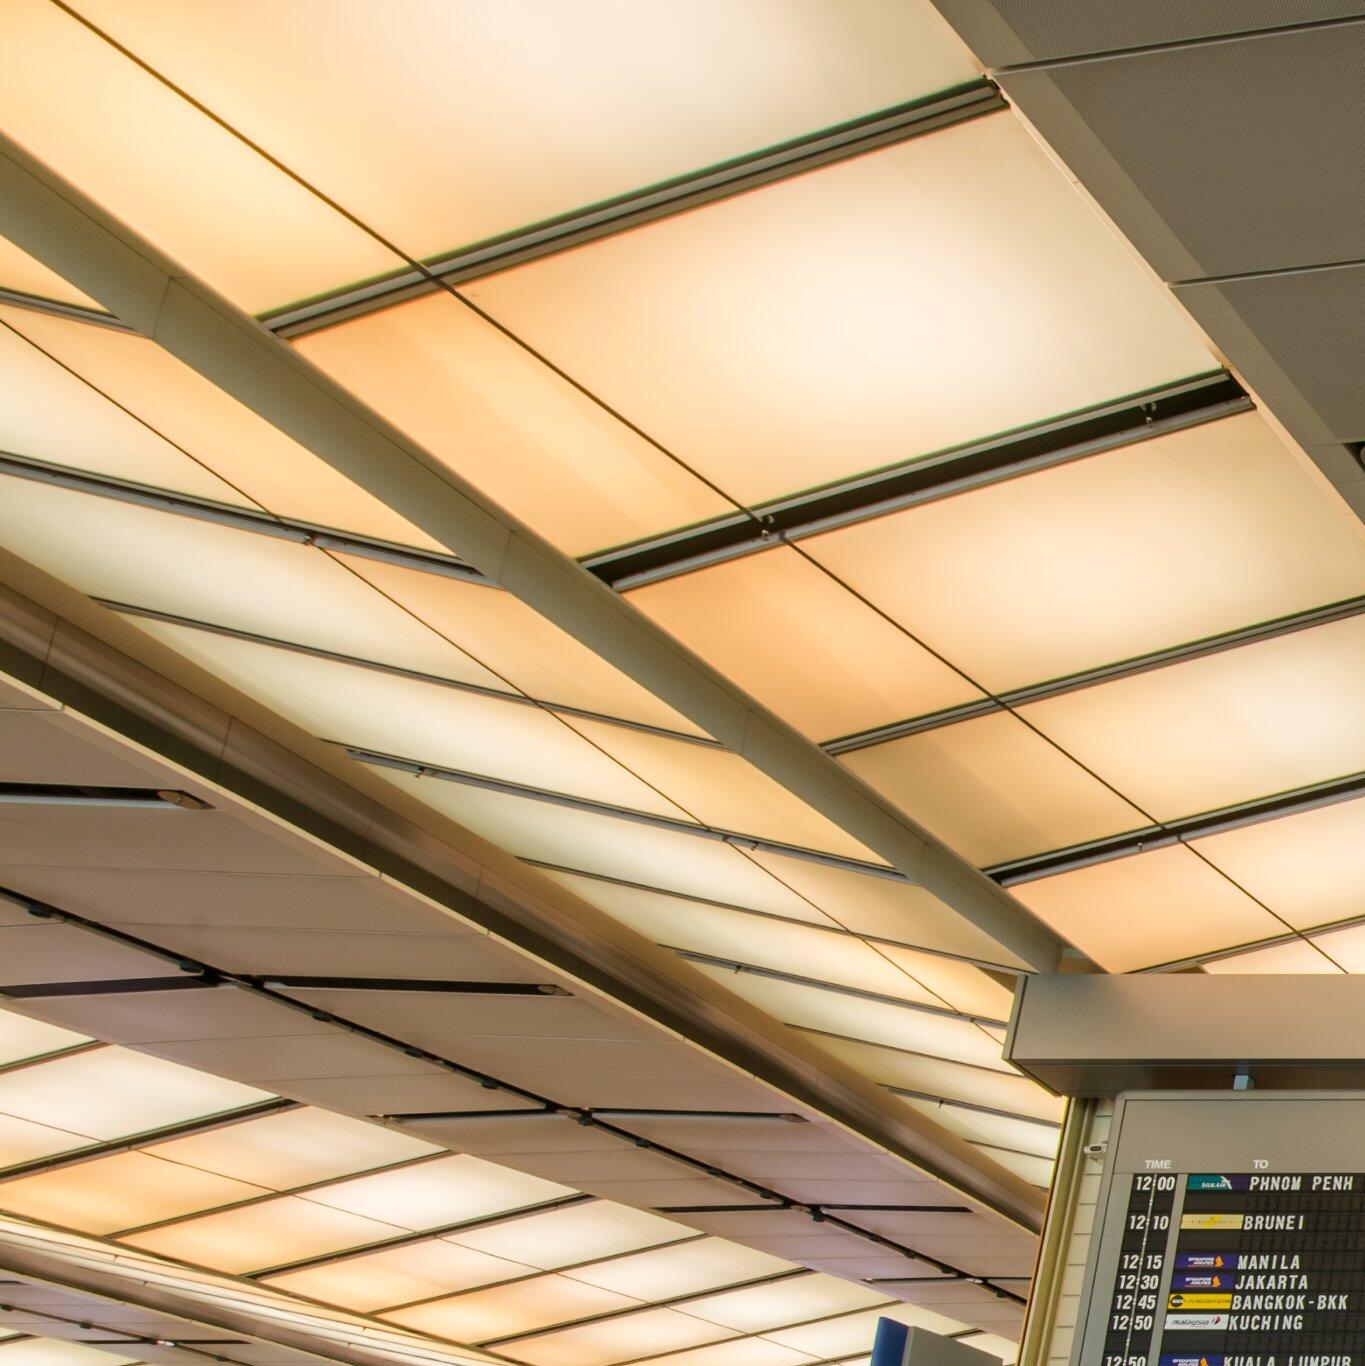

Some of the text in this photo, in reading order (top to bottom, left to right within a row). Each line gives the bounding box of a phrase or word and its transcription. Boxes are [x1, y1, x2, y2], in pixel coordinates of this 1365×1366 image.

[1144, 1160, 1171, 1169] TIME
[1253, 1160, 1268, 1169] TO
[1249, 1176, 1353, 1191] PHNOM PENH
[1244, 1215, 1304, 1230] BRUNEI
[1238, 1255, 1300, 1270] MANILA
[1235, 1275, 1308, 1290] JAKARTA
[1232, 1295, 1348, 1310] BANGKOK-BKK
[1229, 1315, 1303, 1330] KUCHING
